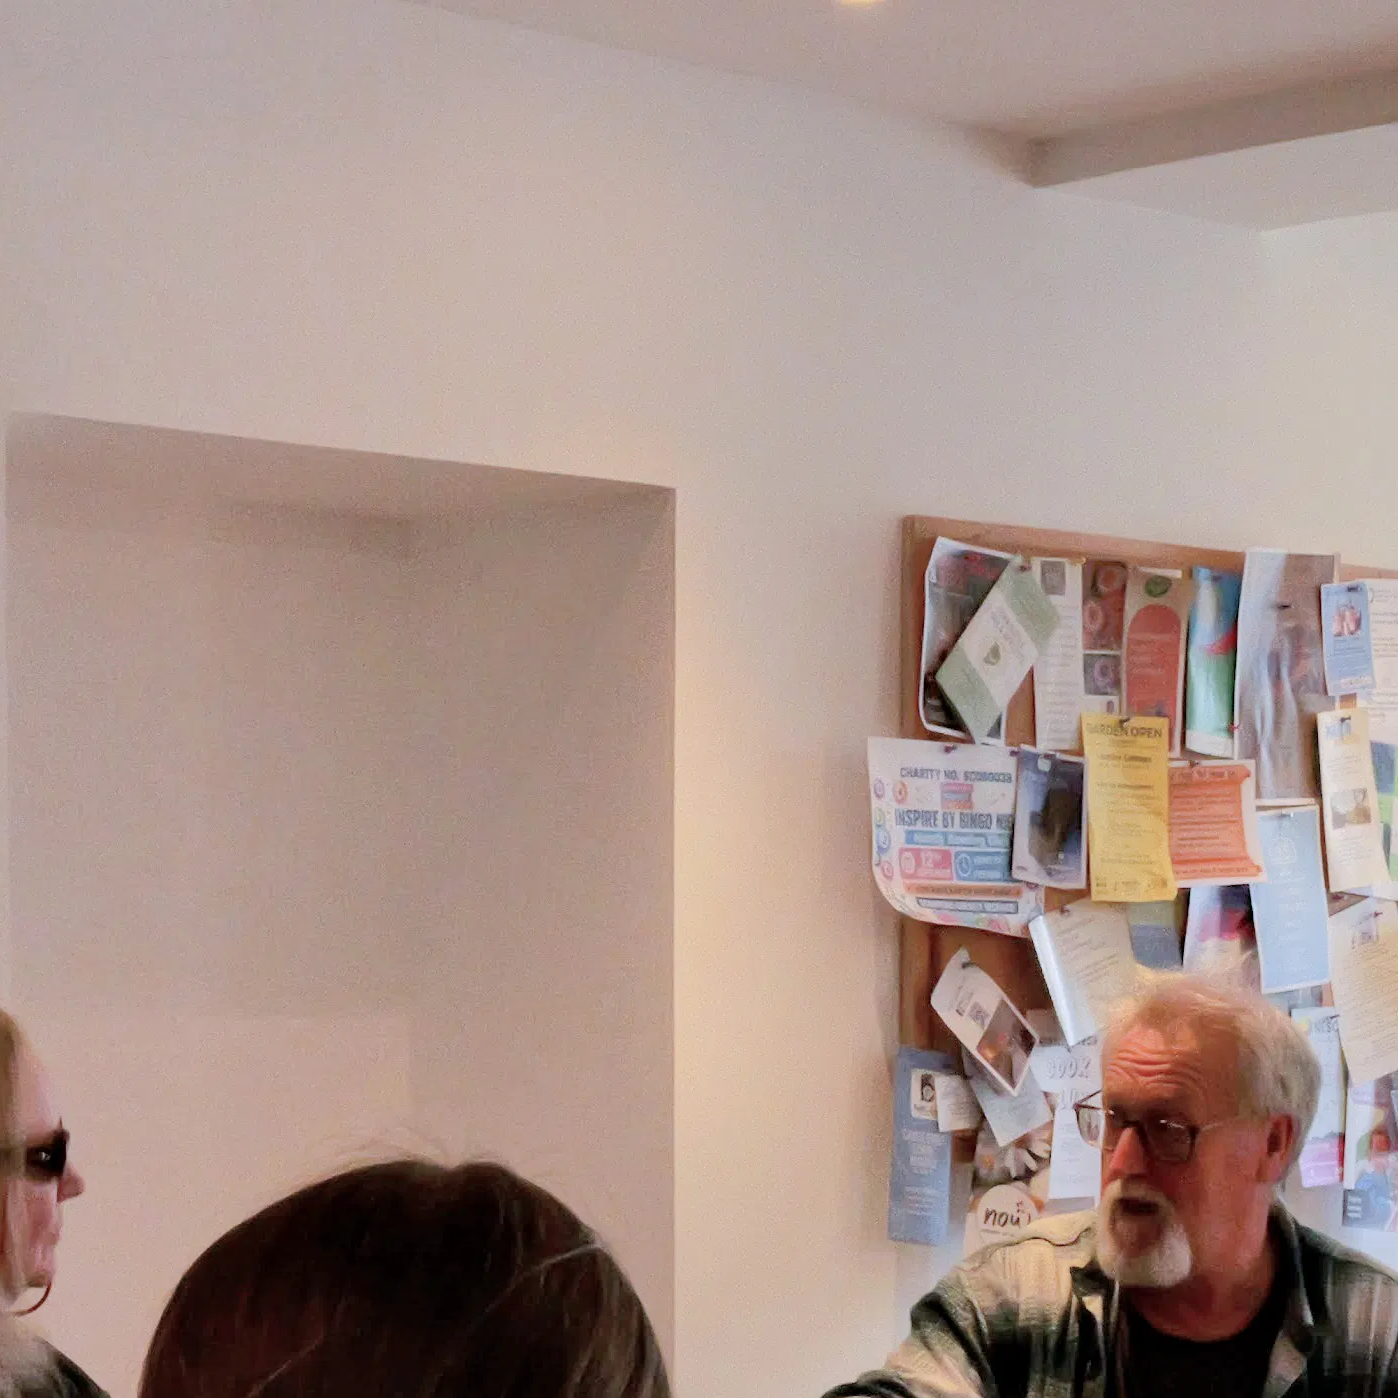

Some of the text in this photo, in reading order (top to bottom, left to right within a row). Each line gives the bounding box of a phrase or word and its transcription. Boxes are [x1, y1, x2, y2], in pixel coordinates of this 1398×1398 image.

[1130, 725, 1163, 739] OPEN
[900, 767, 941, 780] CHARITY
[894, 808, 939, 827] INSPIRE
[942, 811, 956, 829] BY
[959, 812, 993, 830] BINGO
